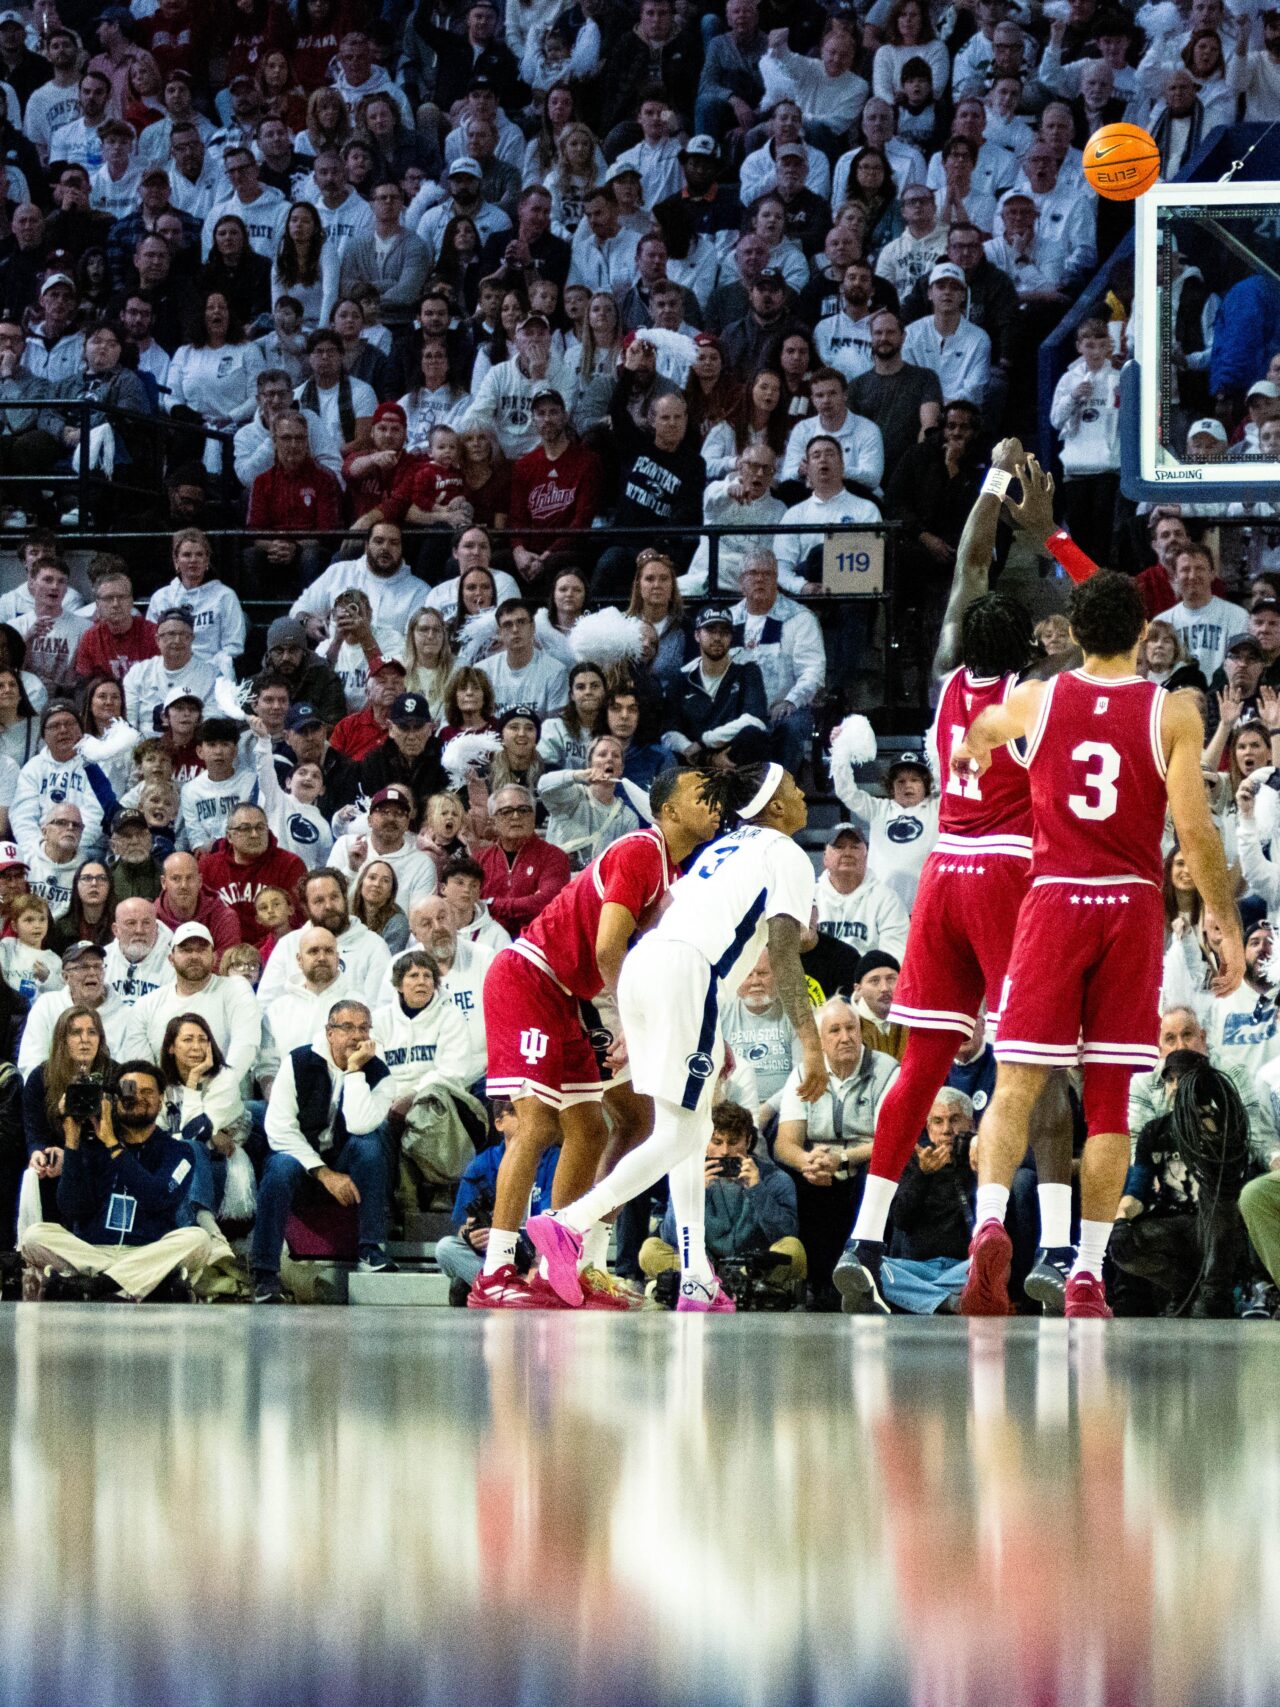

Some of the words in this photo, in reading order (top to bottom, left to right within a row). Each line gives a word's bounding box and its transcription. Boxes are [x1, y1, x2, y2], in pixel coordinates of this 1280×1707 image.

[1097, 167, 1138, 184] ELITE
[1154, 468, 1203, 482] SPALDING
[835, 552, 870, 573] 119
[1067, 740, 1122, 822] 3
[195, 798, 217, 823] PENN
[698, 844, 742, 880] 3
[519, 1026, 550, 1065] IU
[758, 1027, 785, 1042] STATE
